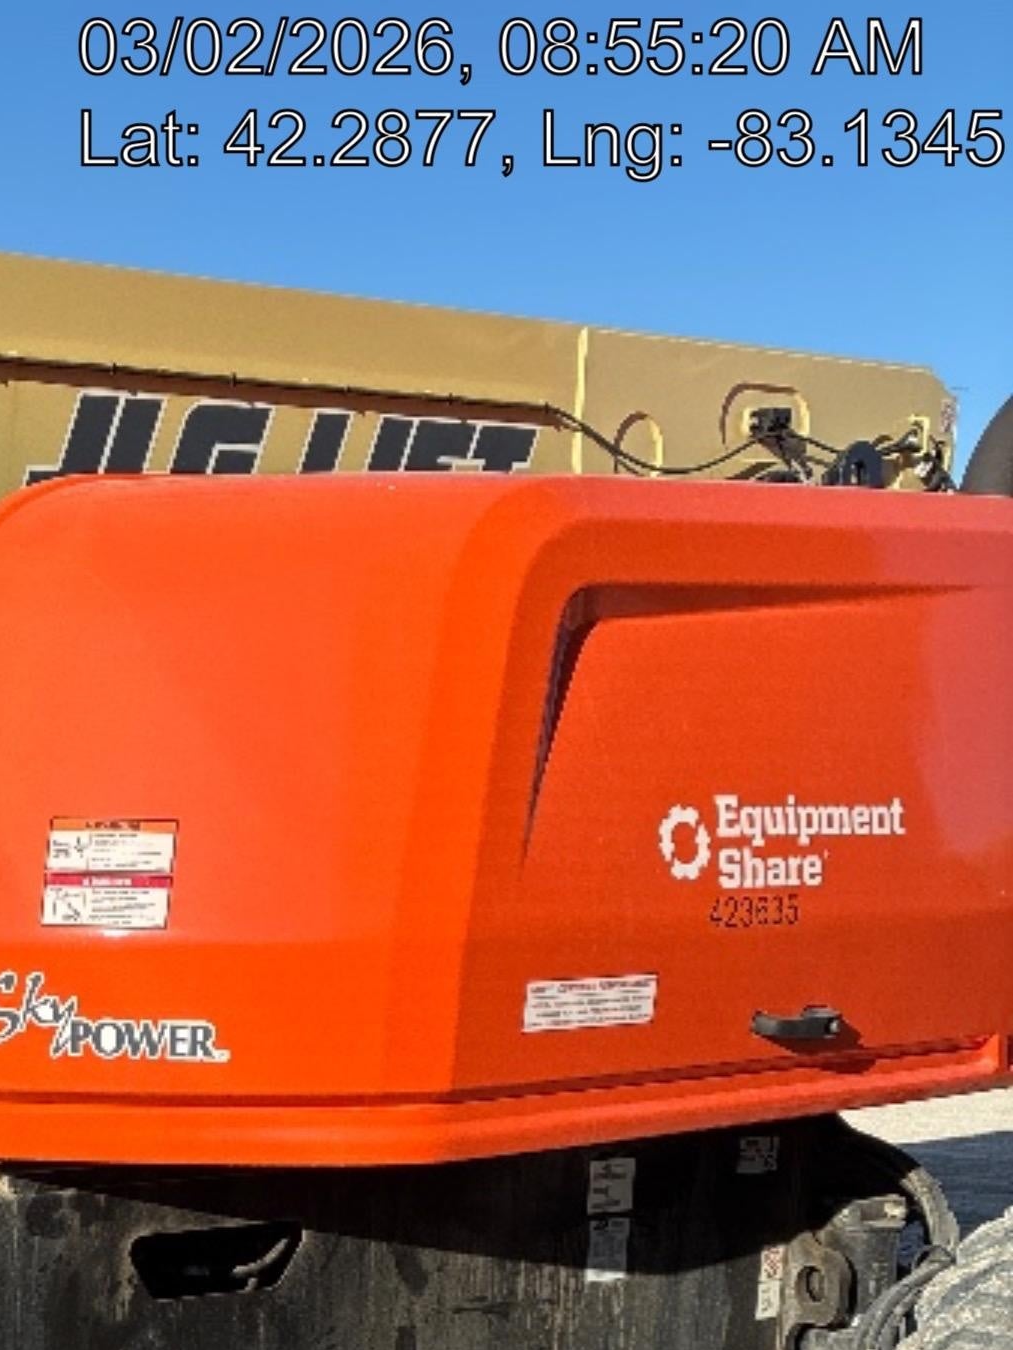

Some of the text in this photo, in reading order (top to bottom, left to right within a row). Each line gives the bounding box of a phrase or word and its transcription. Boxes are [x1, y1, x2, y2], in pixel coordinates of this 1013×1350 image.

[713, 794, 906, 847] Equipment
[717, 847, 823, 889] Share
[68, 1019, 218, 1061] POWER
